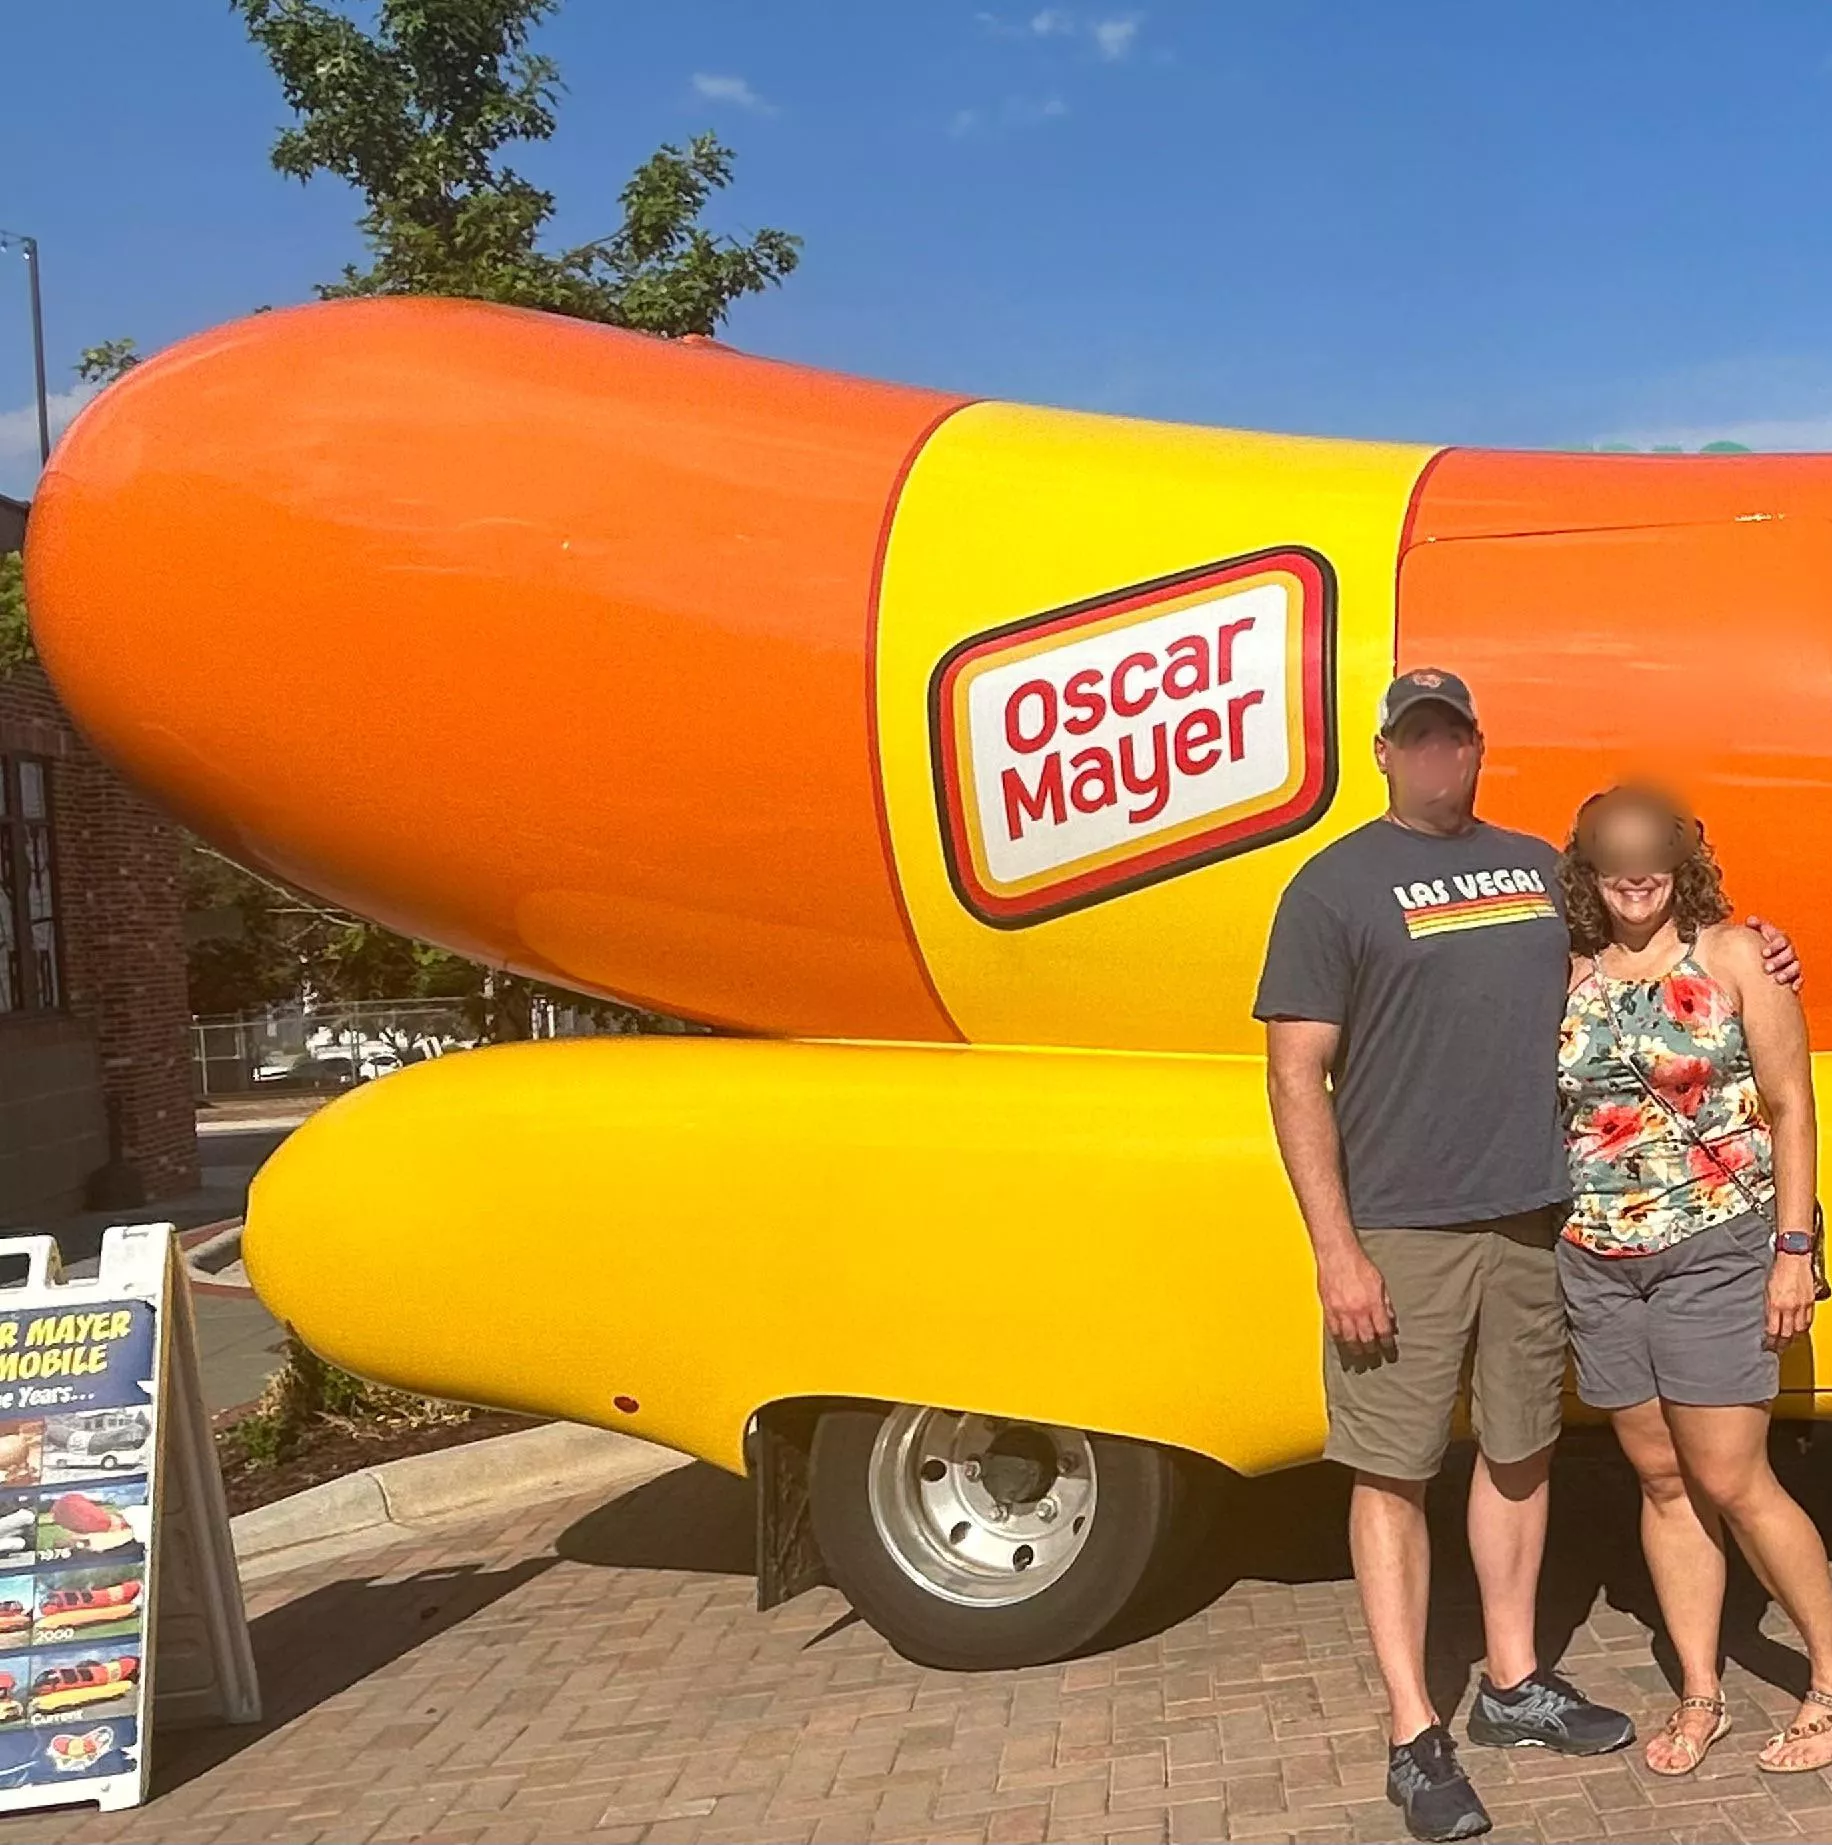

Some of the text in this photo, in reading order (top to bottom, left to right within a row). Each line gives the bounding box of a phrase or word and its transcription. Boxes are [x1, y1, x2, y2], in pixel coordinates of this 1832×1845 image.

[1004, 616, 1256, 755] Oscar
[1001, 688, 1265, 842] Mayer
[1393, 869, 1546, 909] LAS VEGAS
[24, 1310, 132, 1347] MAYER
